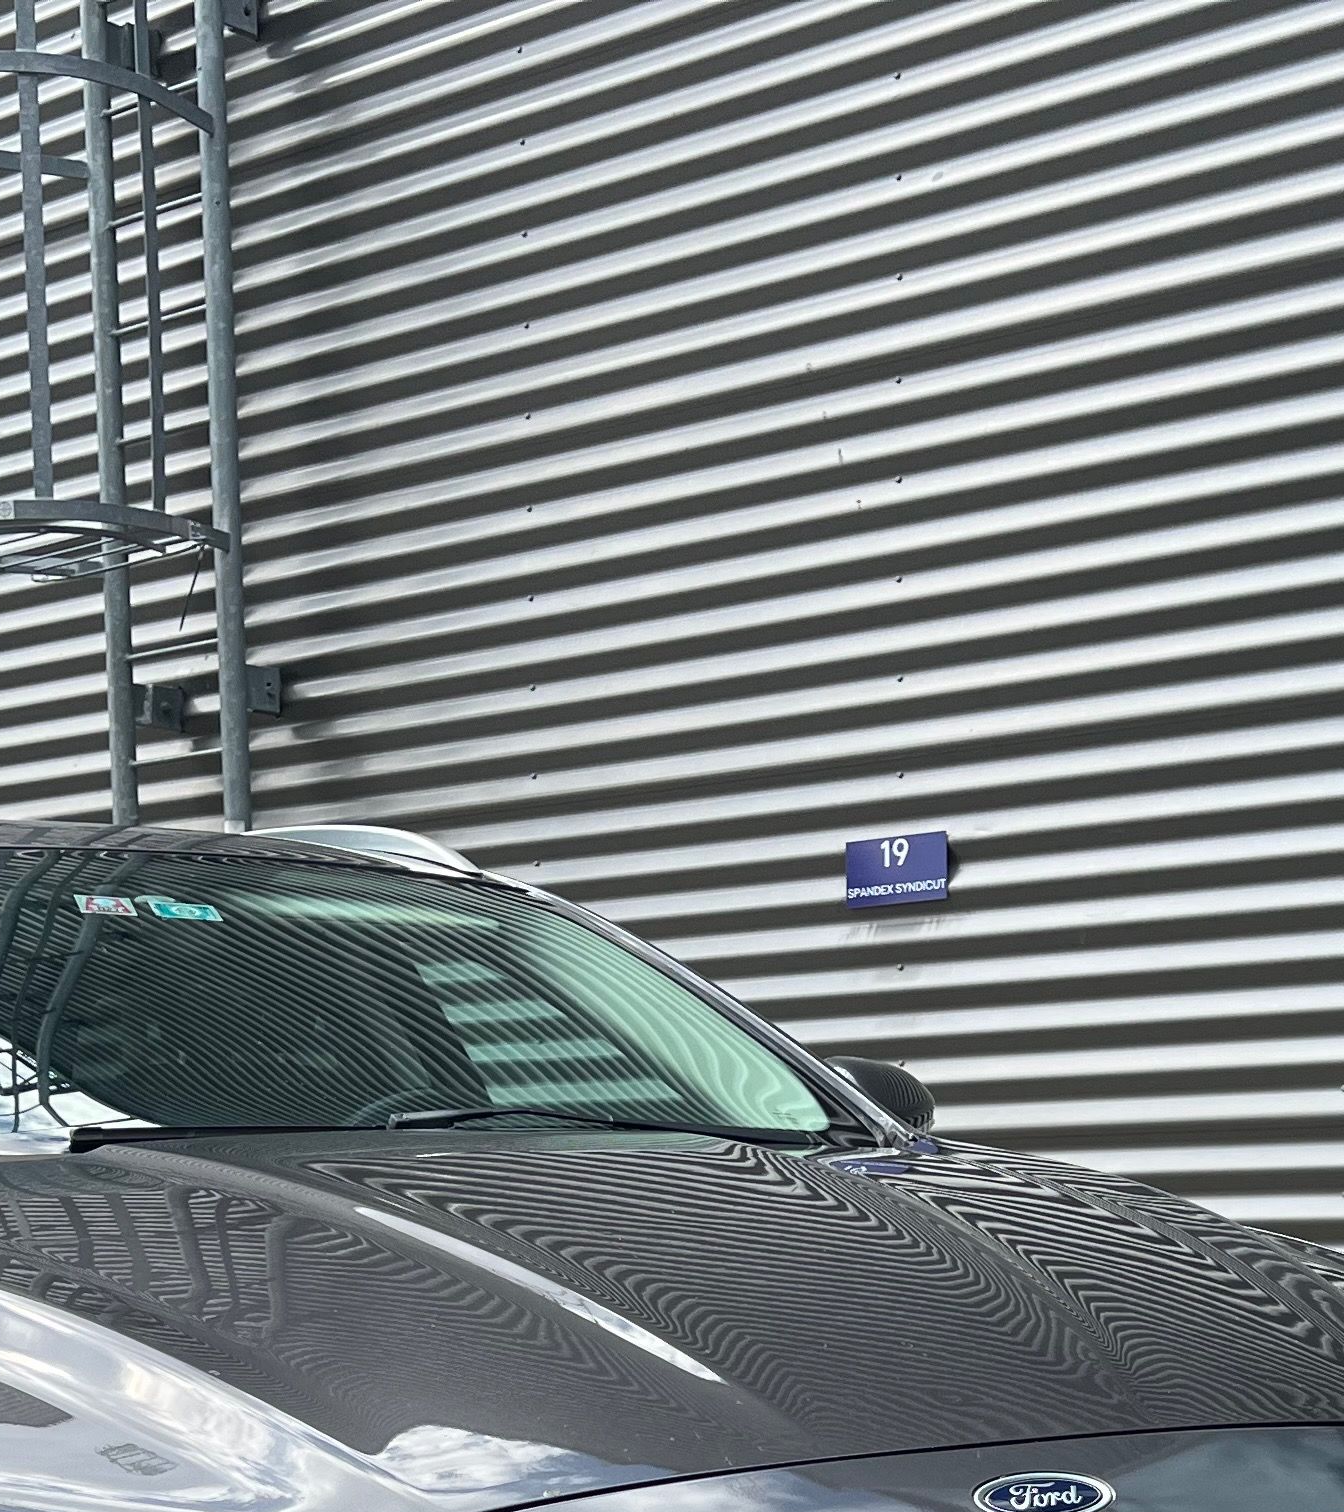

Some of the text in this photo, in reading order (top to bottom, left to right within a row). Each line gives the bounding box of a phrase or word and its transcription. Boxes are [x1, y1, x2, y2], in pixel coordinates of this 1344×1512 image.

[880, 837, 910, 868] 19
[847, 877, 947, 900] SPANDEX SYNDICUT
[1009, 1481, 1084, 1510] Ford
